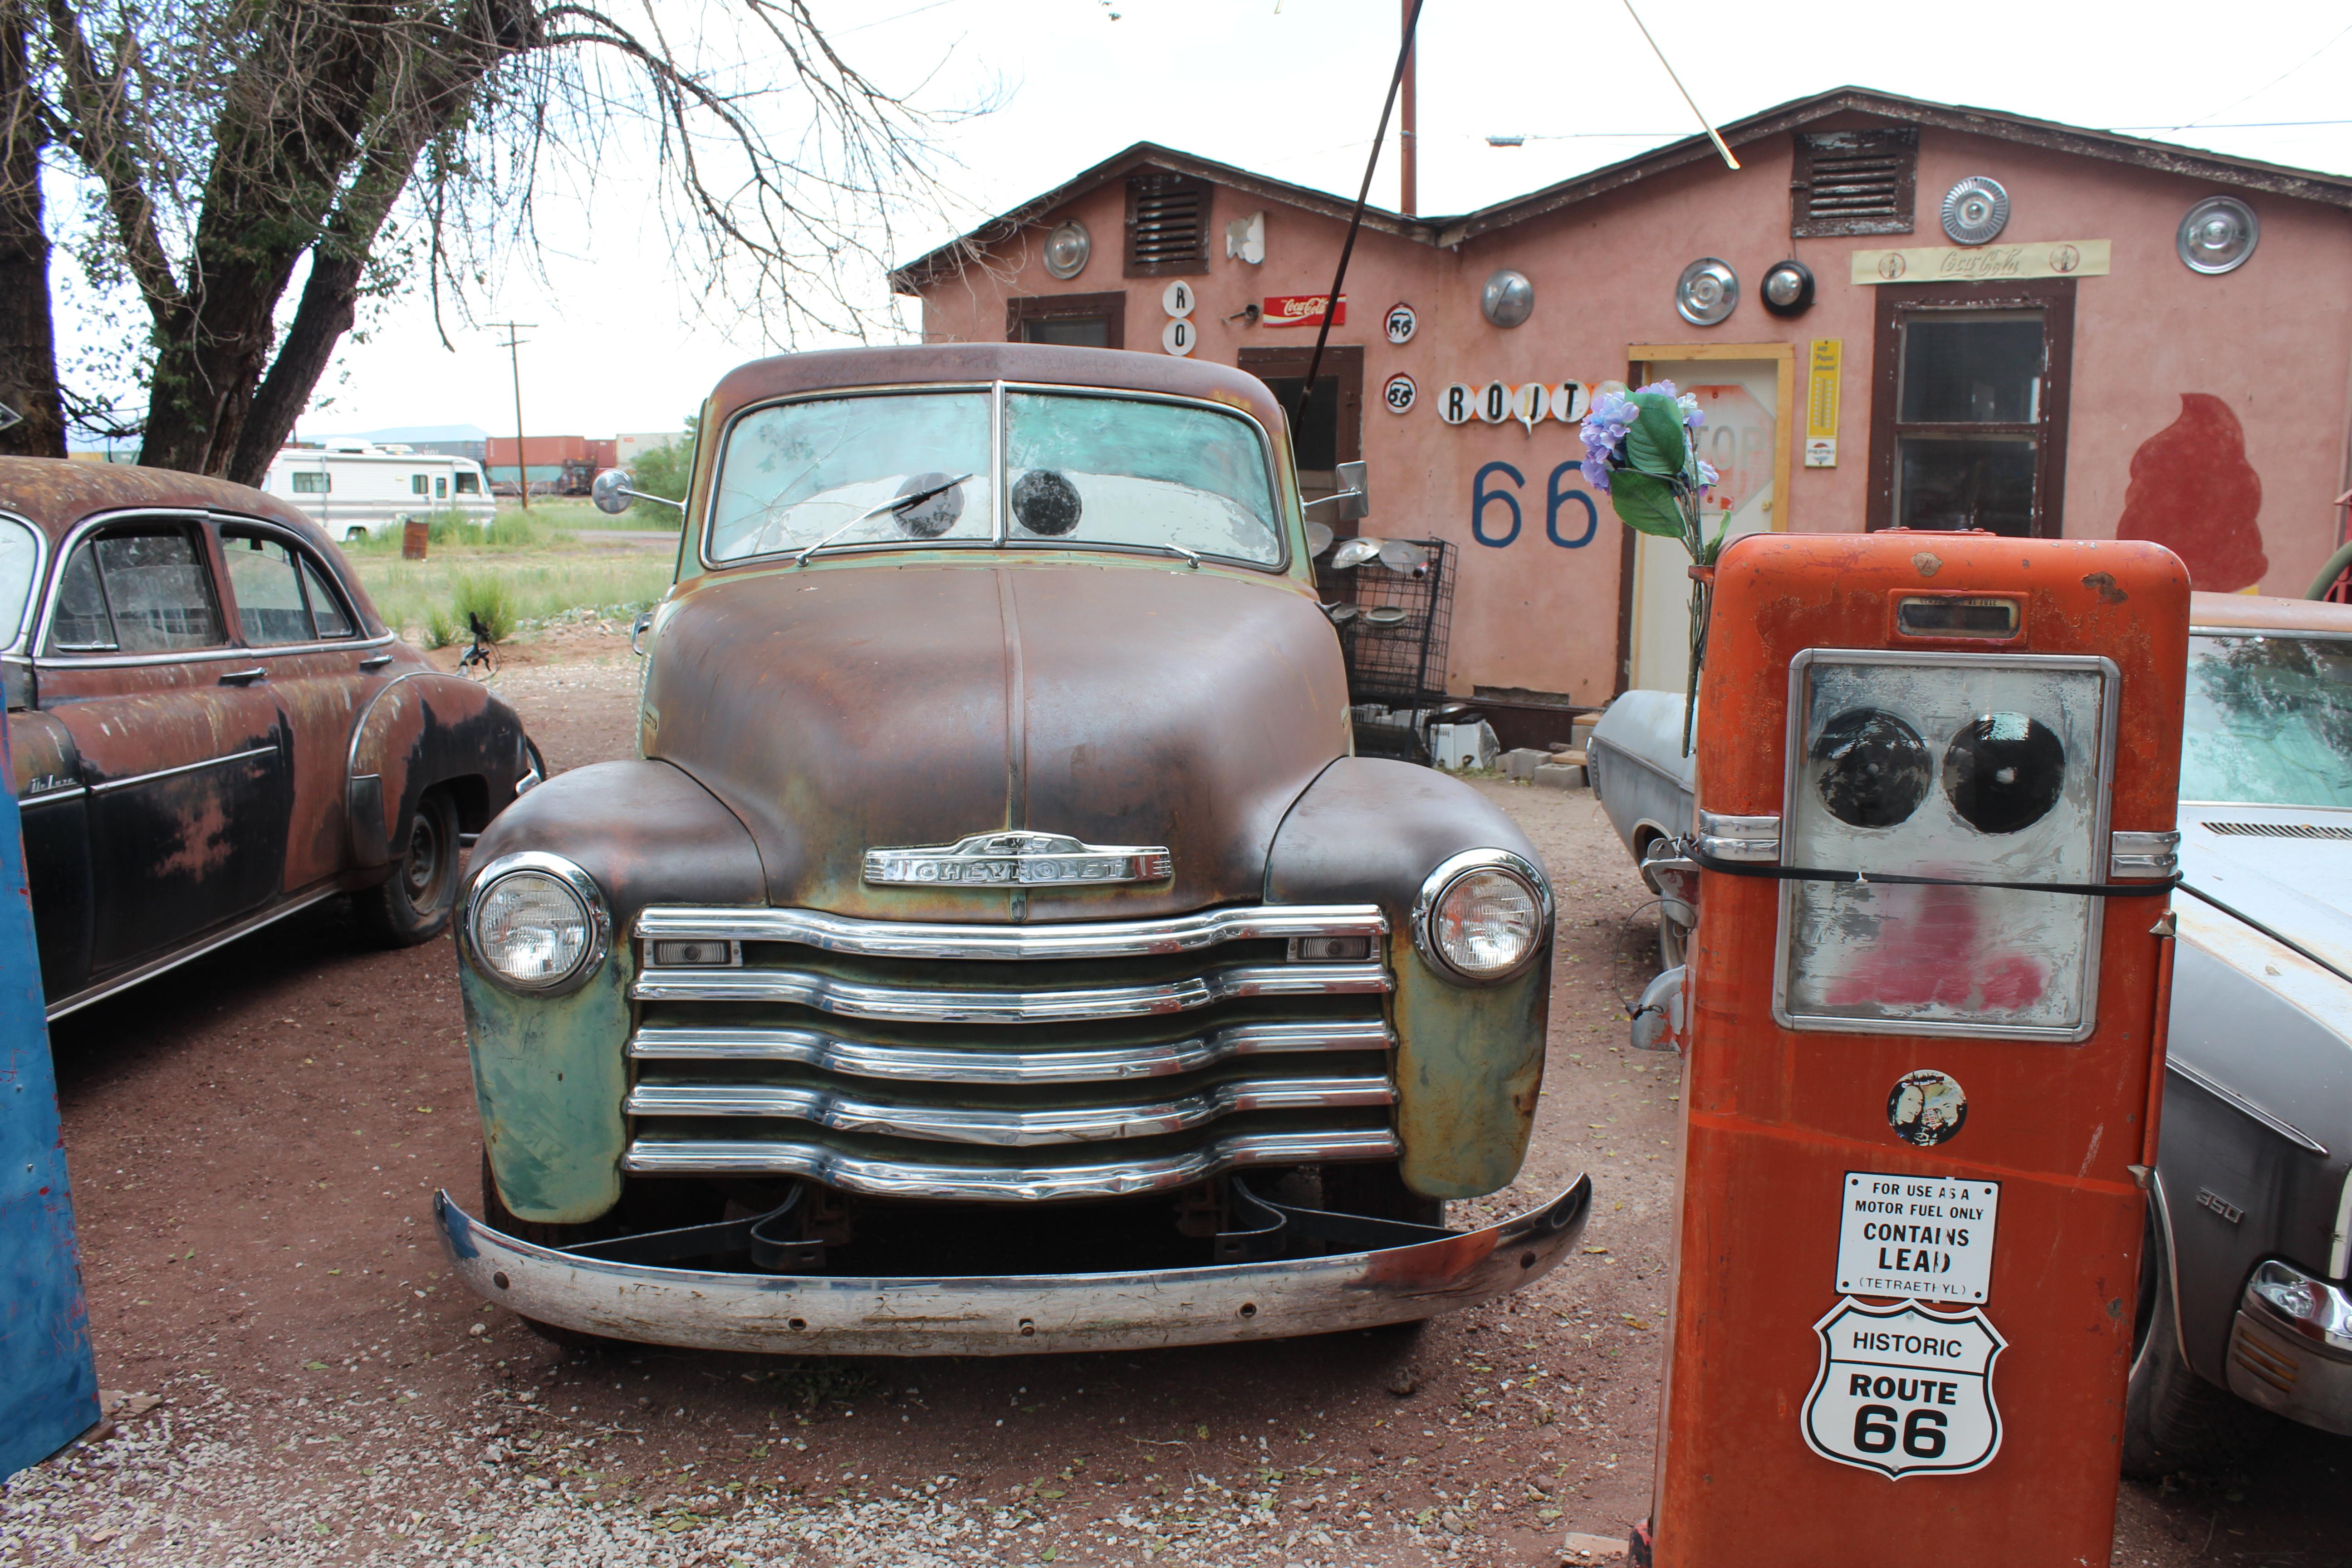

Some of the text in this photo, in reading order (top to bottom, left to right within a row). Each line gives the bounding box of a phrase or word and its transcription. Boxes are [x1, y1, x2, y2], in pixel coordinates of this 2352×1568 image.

[1940, 248, 2022, 277] Coca-Cola
[1387, 388, 1413, 407] 66
[1449, 383, 1578, 421] ROUT
[1694, 425, 1766, 471] TOP
[1472, 460, 1597, 549] 66
[916, 862, 1122, 880] CHEVROLET
[1873, 1182, 1970, 1200] FOR USE AS A
[2196, 1187, 2243, 1223] 350
[1855, 1200, 1984, 1220] MOTOR FUEL ONLY
[1864, 1222, 1969, 1247] CONTAINS
[1879, 1247, 1950, 1274] LEAD
[1853, 1332, 1962, 1358] HISTORIC
[1850, 1373, 1958, 1405] ROUTE
[1854, 1404, 1948, 1459] 66
